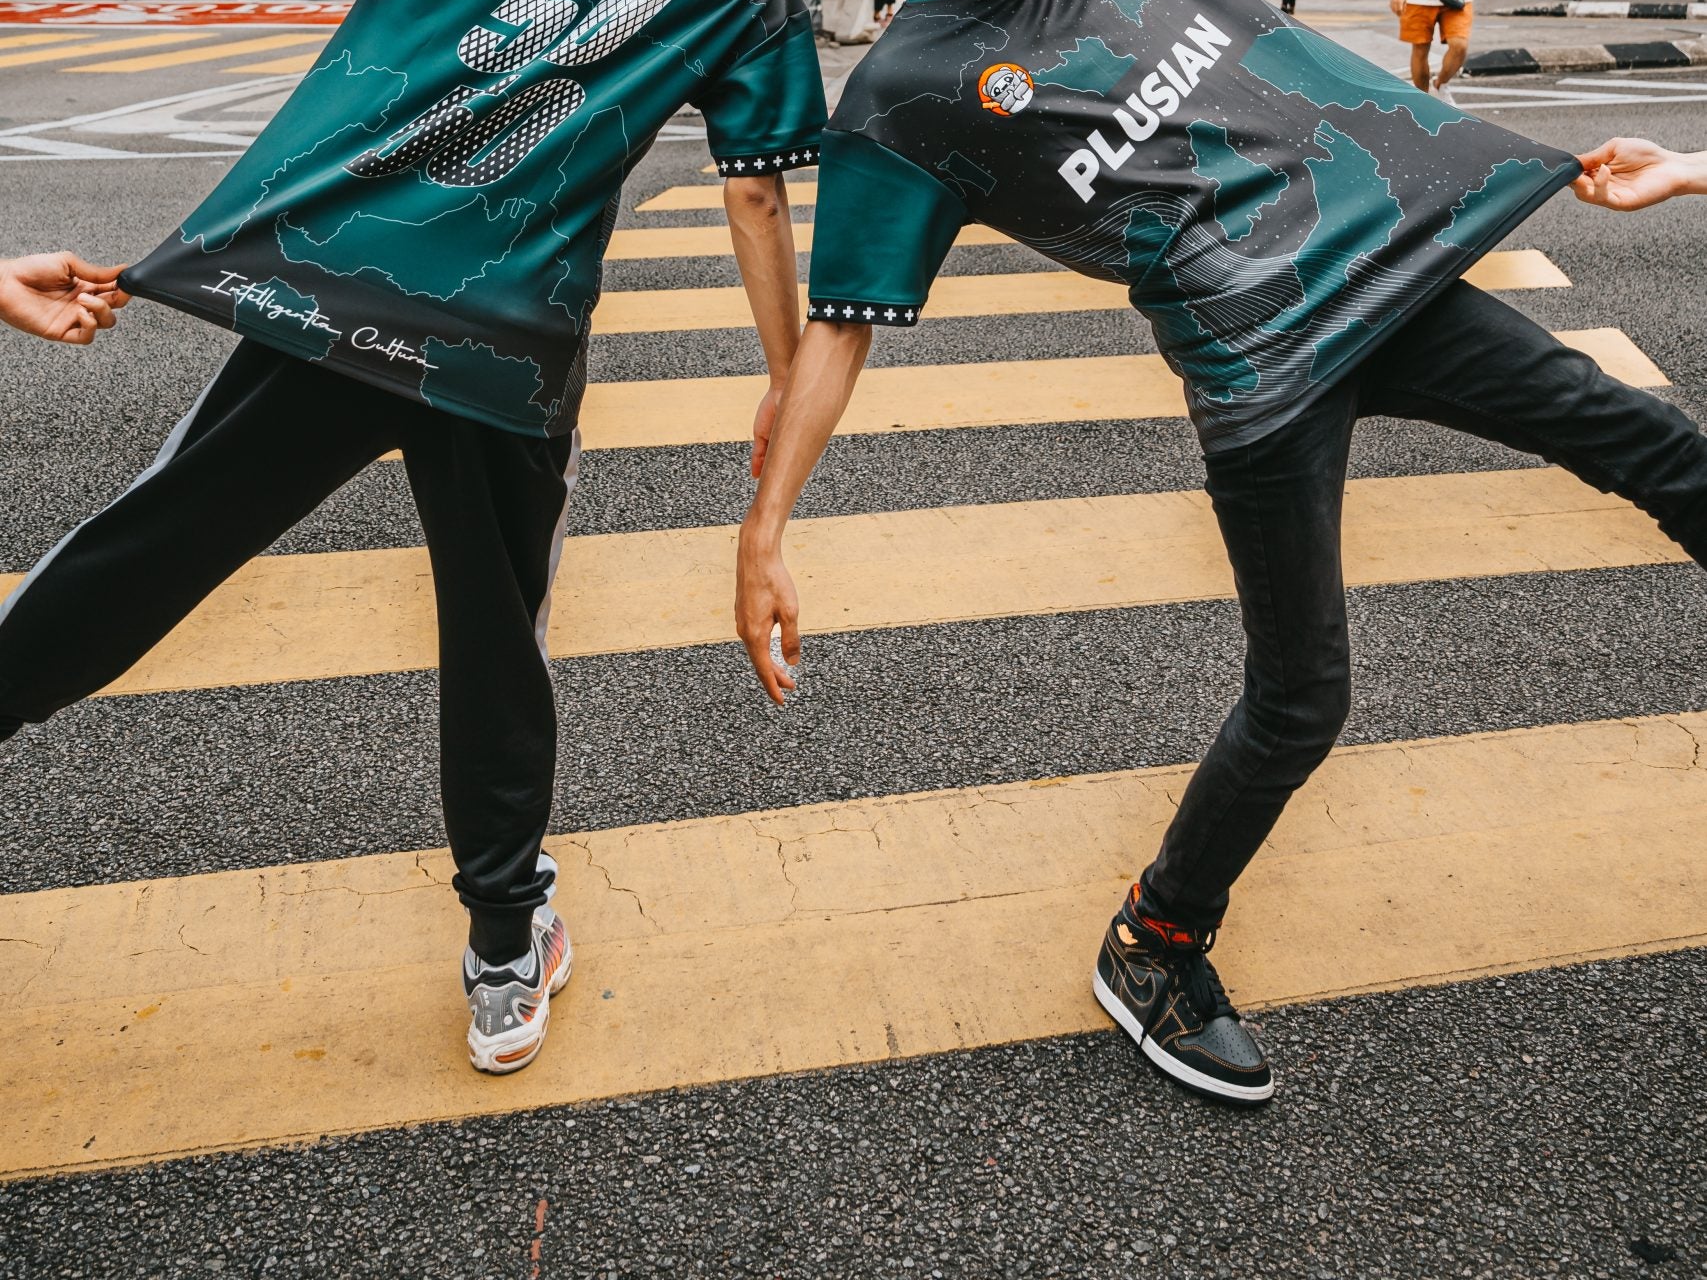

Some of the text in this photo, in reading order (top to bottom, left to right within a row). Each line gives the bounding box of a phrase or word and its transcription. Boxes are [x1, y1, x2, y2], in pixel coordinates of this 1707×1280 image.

[1058, 13, 1232, 204] PLUSIAN
[201, 270, 440, 369] Intelligentia Cultura
